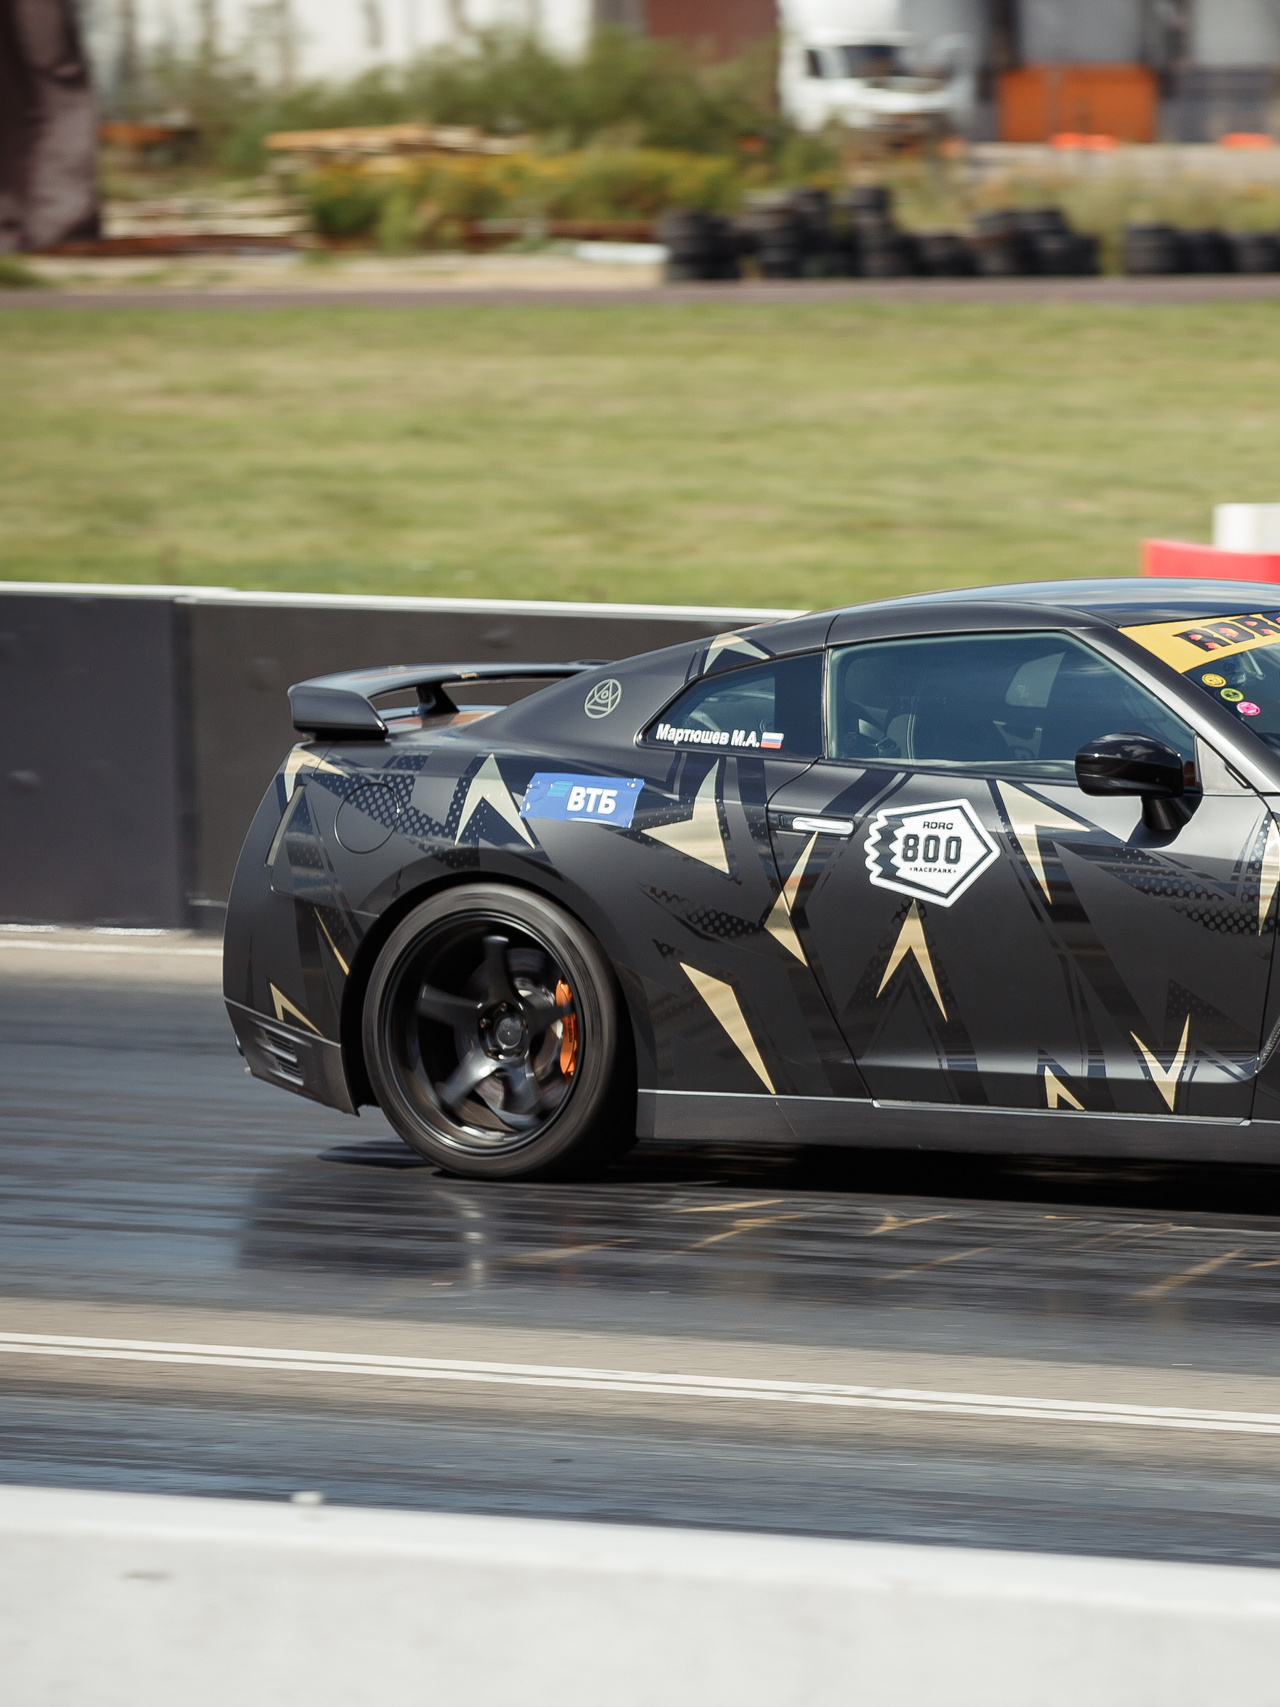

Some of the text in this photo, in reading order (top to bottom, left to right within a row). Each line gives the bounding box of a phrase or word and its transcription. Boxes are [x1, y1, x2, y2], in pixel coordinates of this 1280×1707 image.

[655, 723, 760, 748] Мартюшев М.А.
[566, 786, 618, 815] ВТБ
[922, 821, 954, 830] RDRC
[902, 834, 962, 865] 800
